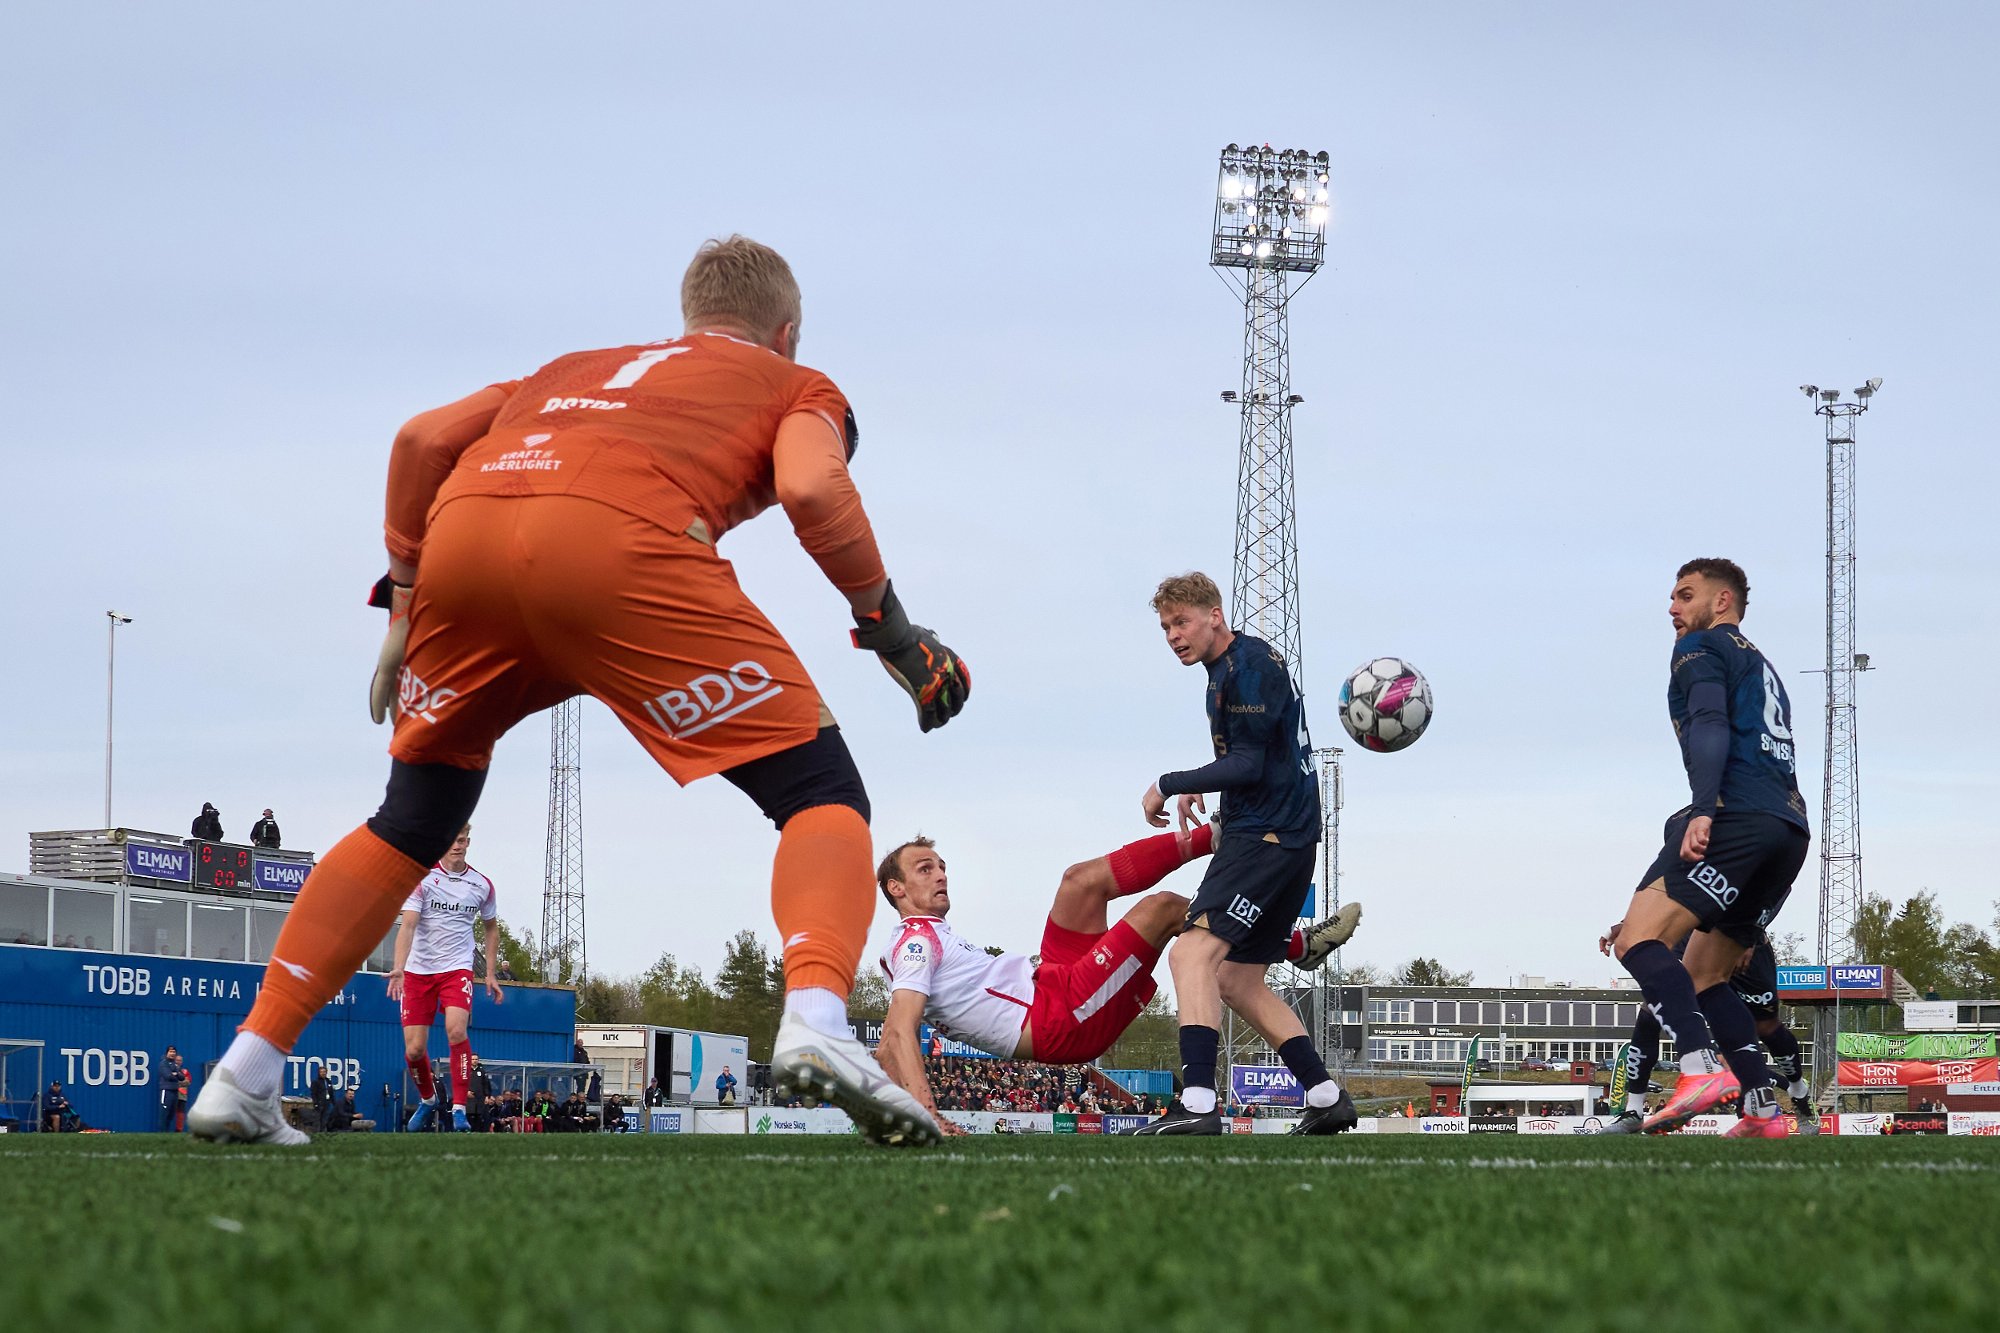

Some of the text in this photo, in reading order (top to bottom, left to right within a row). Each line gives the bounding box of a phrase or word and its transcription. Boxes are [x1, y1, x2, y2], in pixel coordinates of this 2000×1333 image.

[501, 450, 543, 460] KRAFT
[481, 460, 562, 473] KJÆRLIGHET
[656, 661, 775, 730] BDO
[137, 850, 183, 871] ELMAN
[264, 866, 304, 884] ELMAN
[1697, 866, 1739, 905] BDO
[1234, 897, 1263, 923] BD
[1793, 973, 1822, 983] TOBB
[1835, 968, 1877, 979] ELMAN
[82, 964, 151, 996] TOBB
[164, 976, 241, 999] ARENA
[1844, 1034, 1887, 1054] KIWI
[1923, 1035, 1968, 1055] KIWI
[1888, 1048, 1905, 1057] pris
[60, 1048, 150, 1086] TOBB
[1860, 1064, 1899, 1076] THON
[1934, 1062, 1974, 1075] THON
[1244, 1072, 1297, 1087] ELMAN
[1937, 1075, 1973, 1084] HOTELS
[660, 1117, 680, 1130] TOBB
[774, 1120, 793, 1129] Norske
[1432, 1121, 1465, 1131] mobit
[1478, 1123, 1516, 1131] VARMEFAG
[1527, 1120, 1558, 1131] THON
[1897, 1119, 1945, 1130] Scandic
